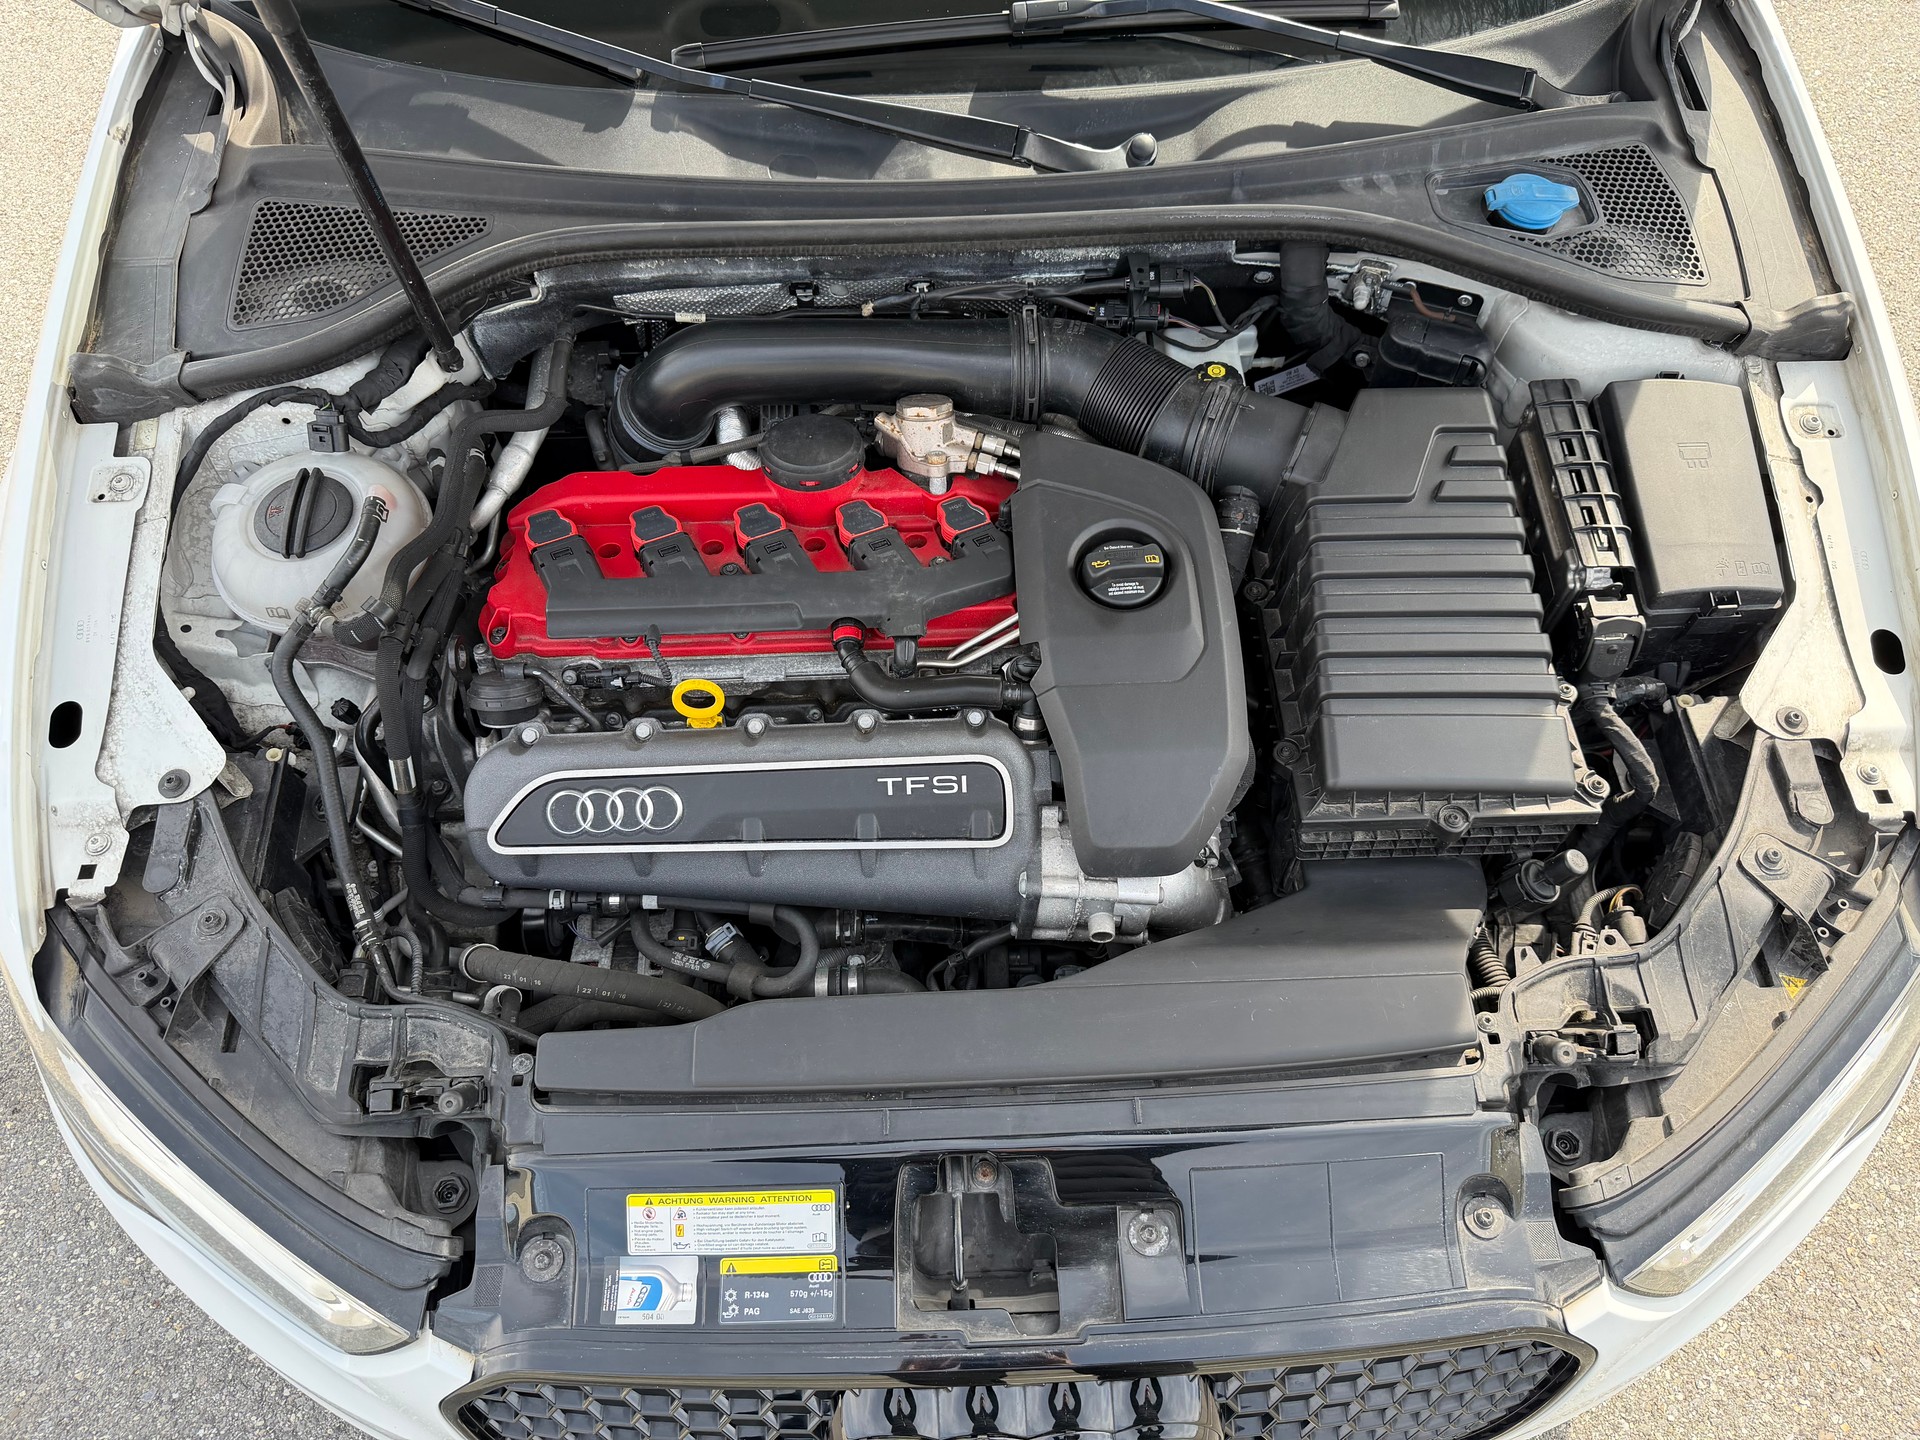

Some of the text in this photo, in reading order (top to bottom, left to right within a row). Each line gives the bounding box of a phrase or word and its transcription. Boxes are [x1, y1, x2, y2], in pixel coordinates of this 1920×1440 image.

[877, 775, 967, 795] TFSI
[658, 1194, 812, 1205] ACHTUNG WARNING ATTENTION
[790, 1290, 808, 1298] 570g
[810, 1289, 833, 1298] +/-15g
